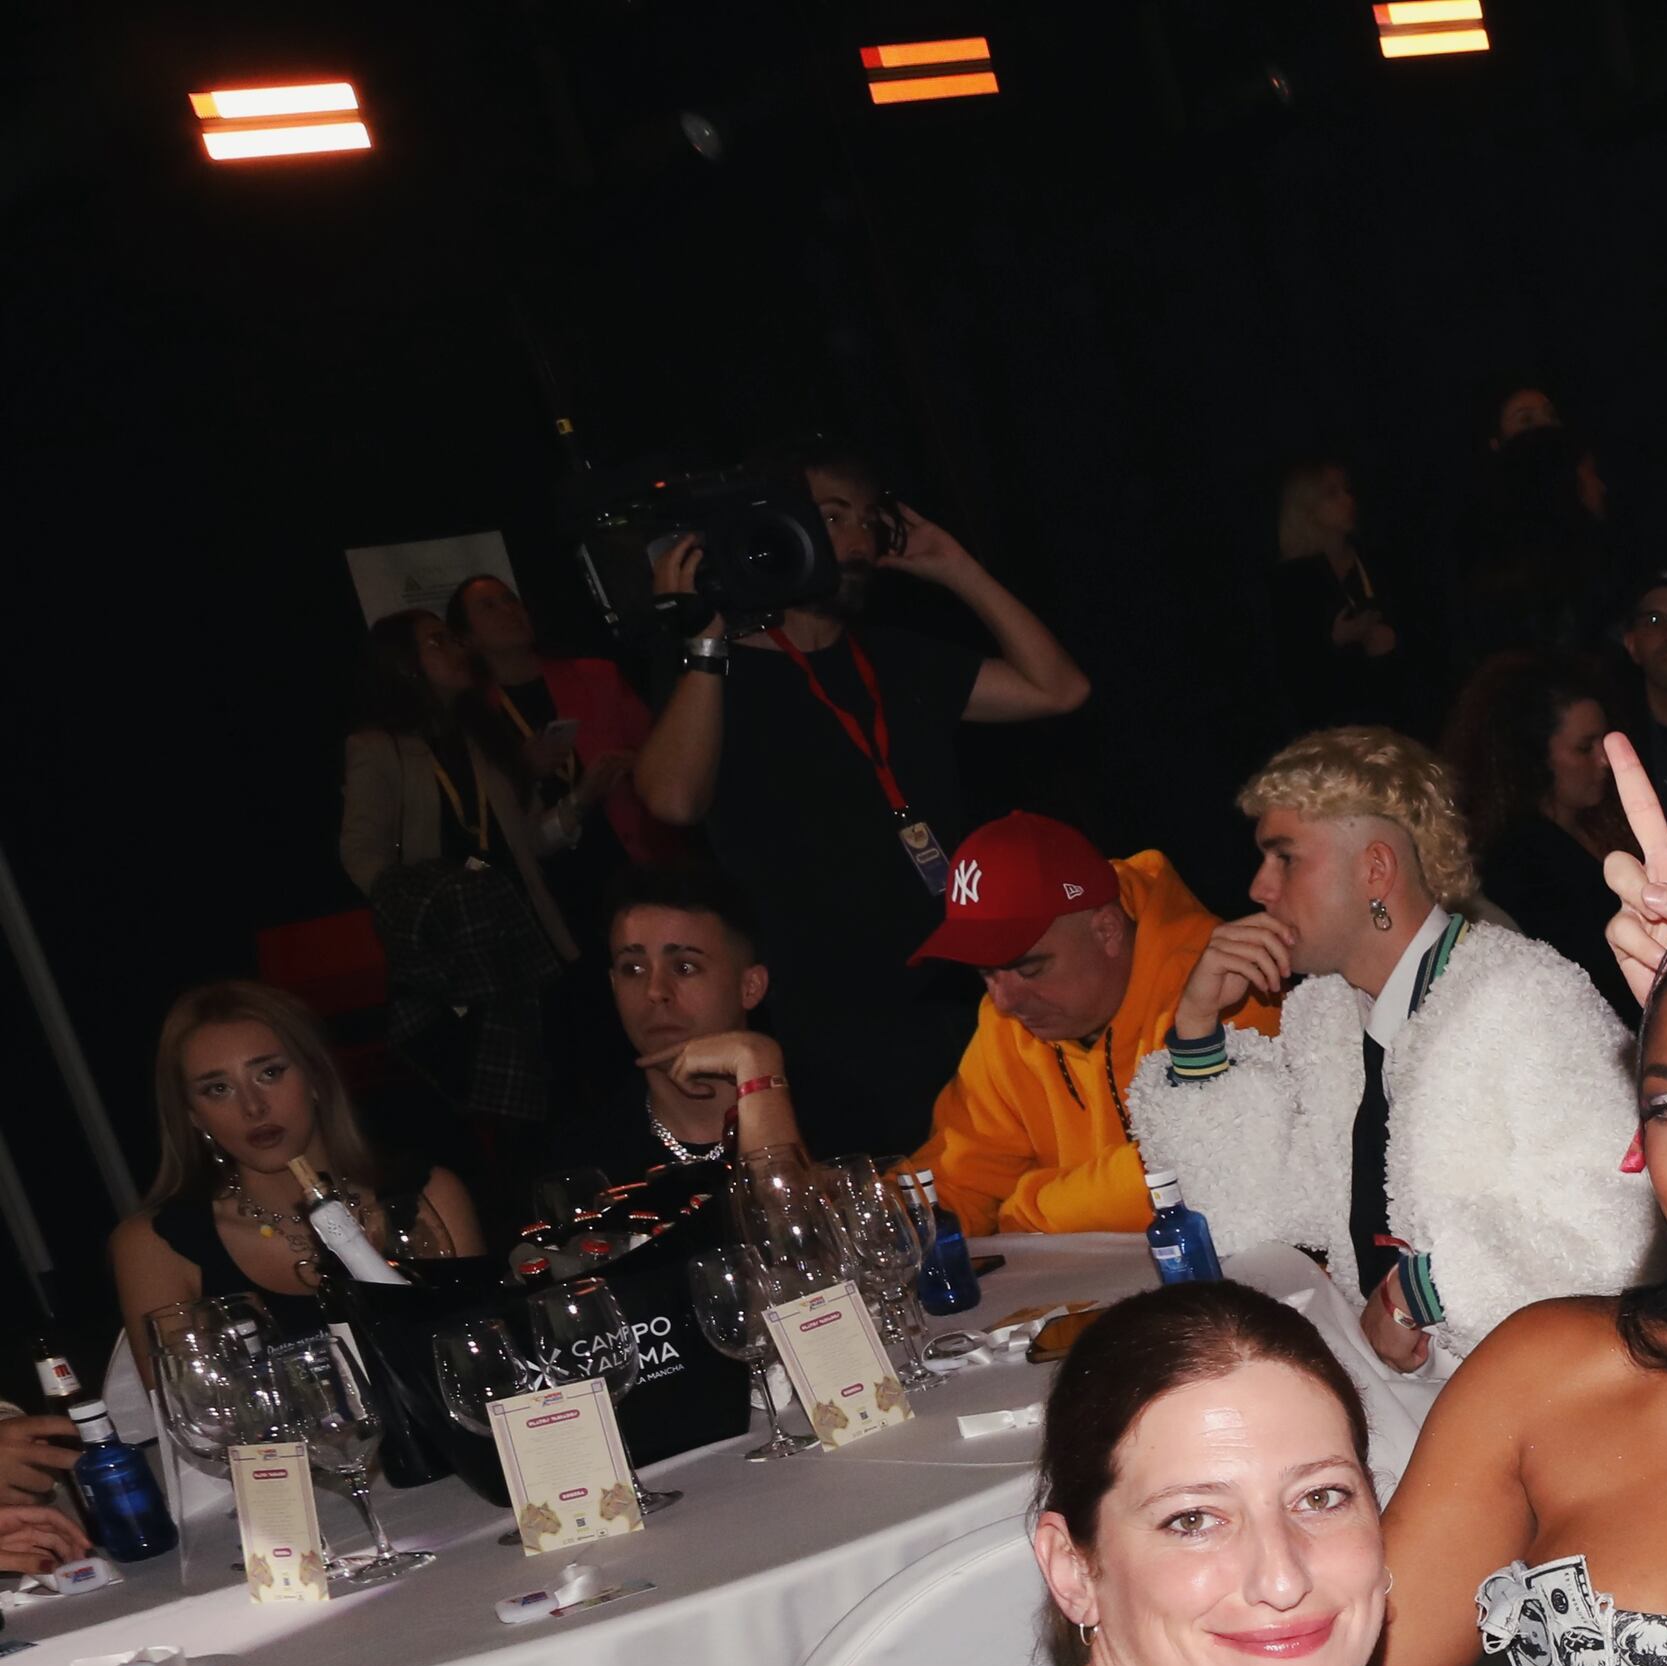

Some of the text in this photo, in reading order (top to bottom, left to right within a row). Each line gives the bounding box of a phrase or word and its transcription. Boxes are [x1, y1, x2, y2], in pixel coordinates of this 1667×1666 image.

[952, 859, 982, 905] NY
[572, 1316, 671, 1356] CAMPO
[648, 1363, 685, 1382] MANCHA
